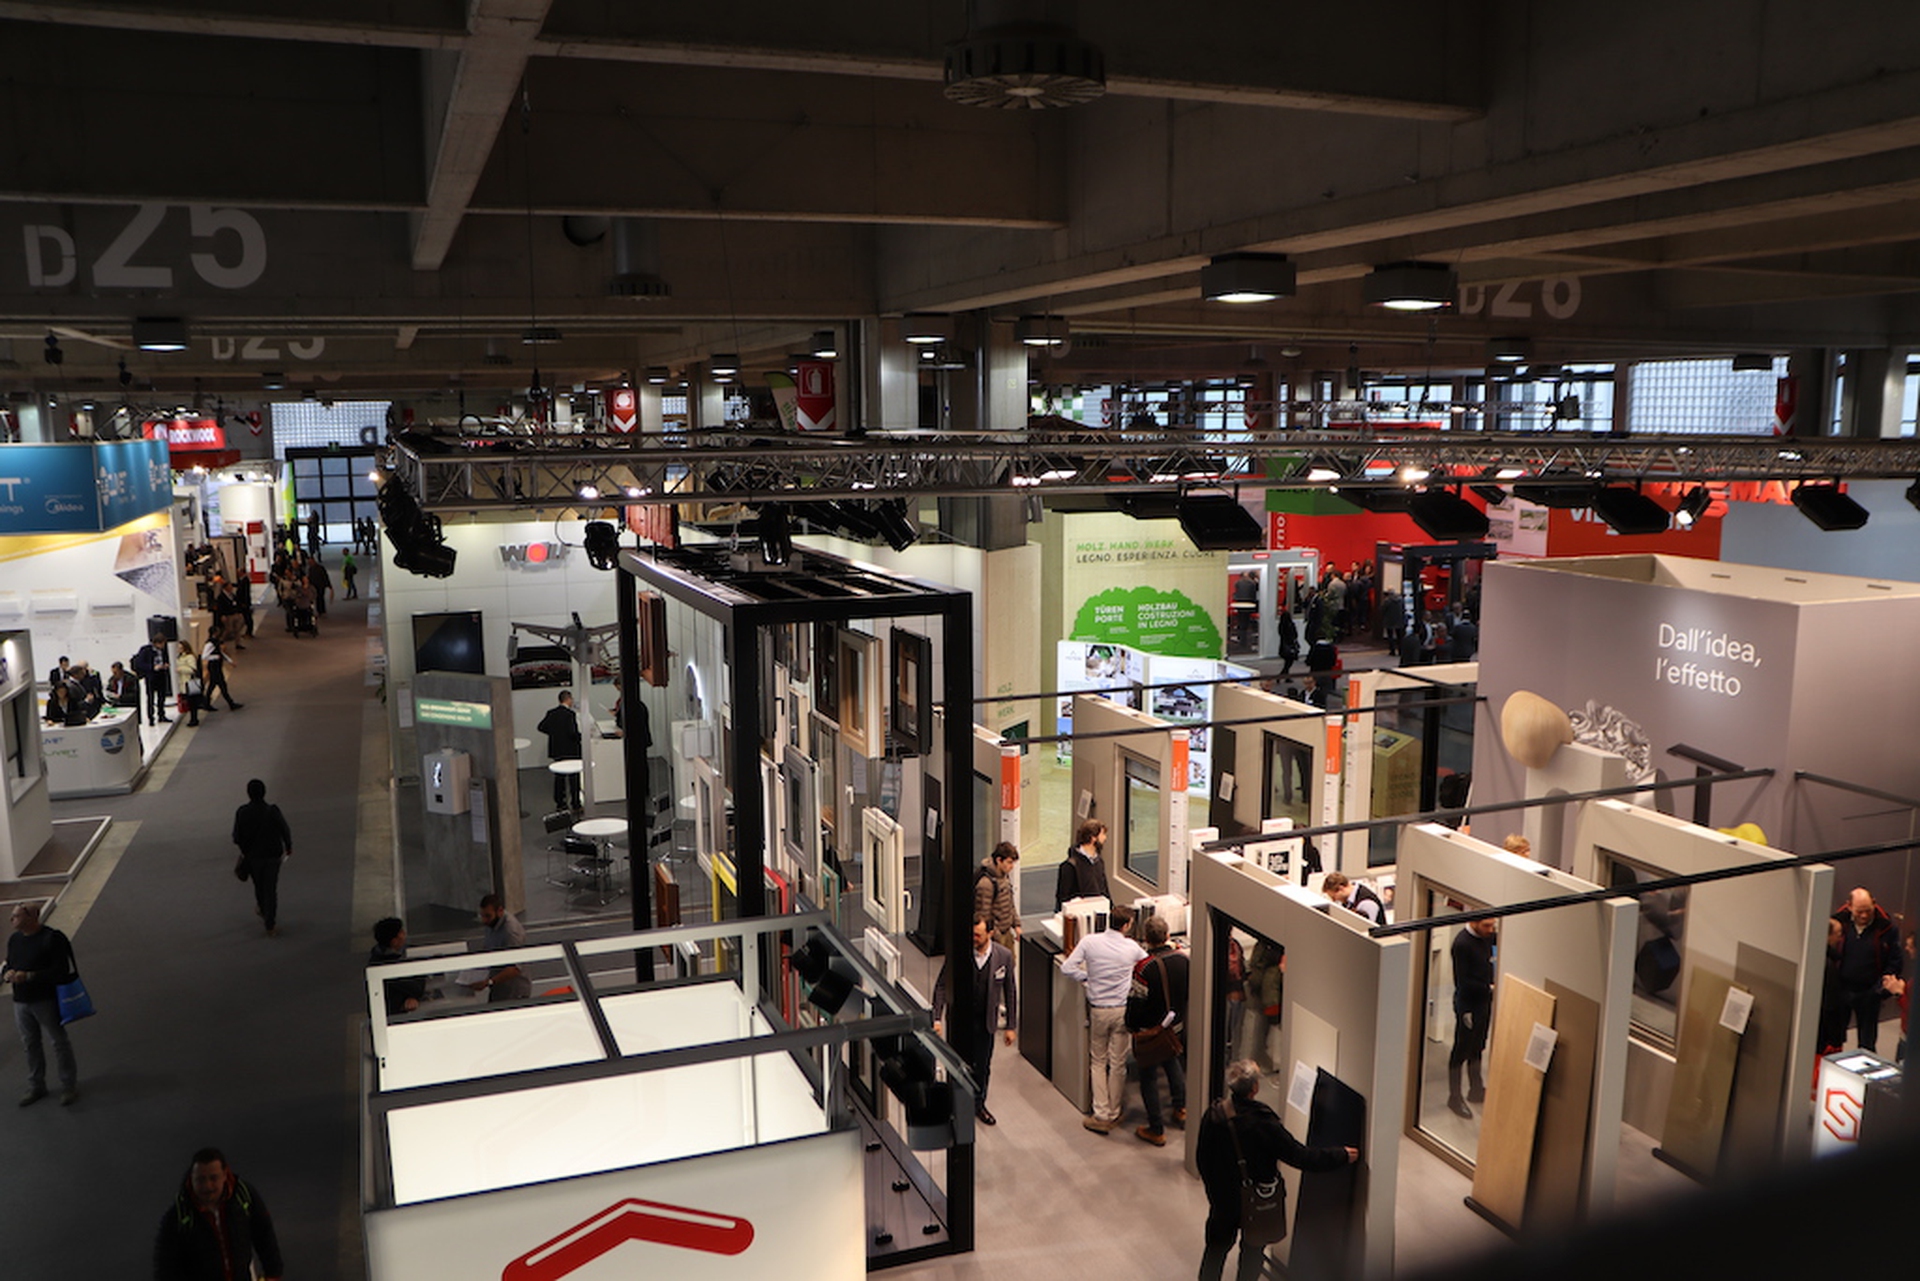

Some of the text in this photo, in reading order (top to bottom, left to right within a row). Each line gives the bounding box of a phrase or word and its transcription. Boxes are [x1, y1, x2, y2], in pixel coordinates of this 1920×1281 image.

[1137, 602, 1178, 612] HOLZBAU
[1094, 613, 1124, 624] PORTE
[1137, 610, 1196, 621] COSTRUZIONI
[1137, 621, 1148, 629] IN
[1149, 619, 1179, 629] LEGNO
